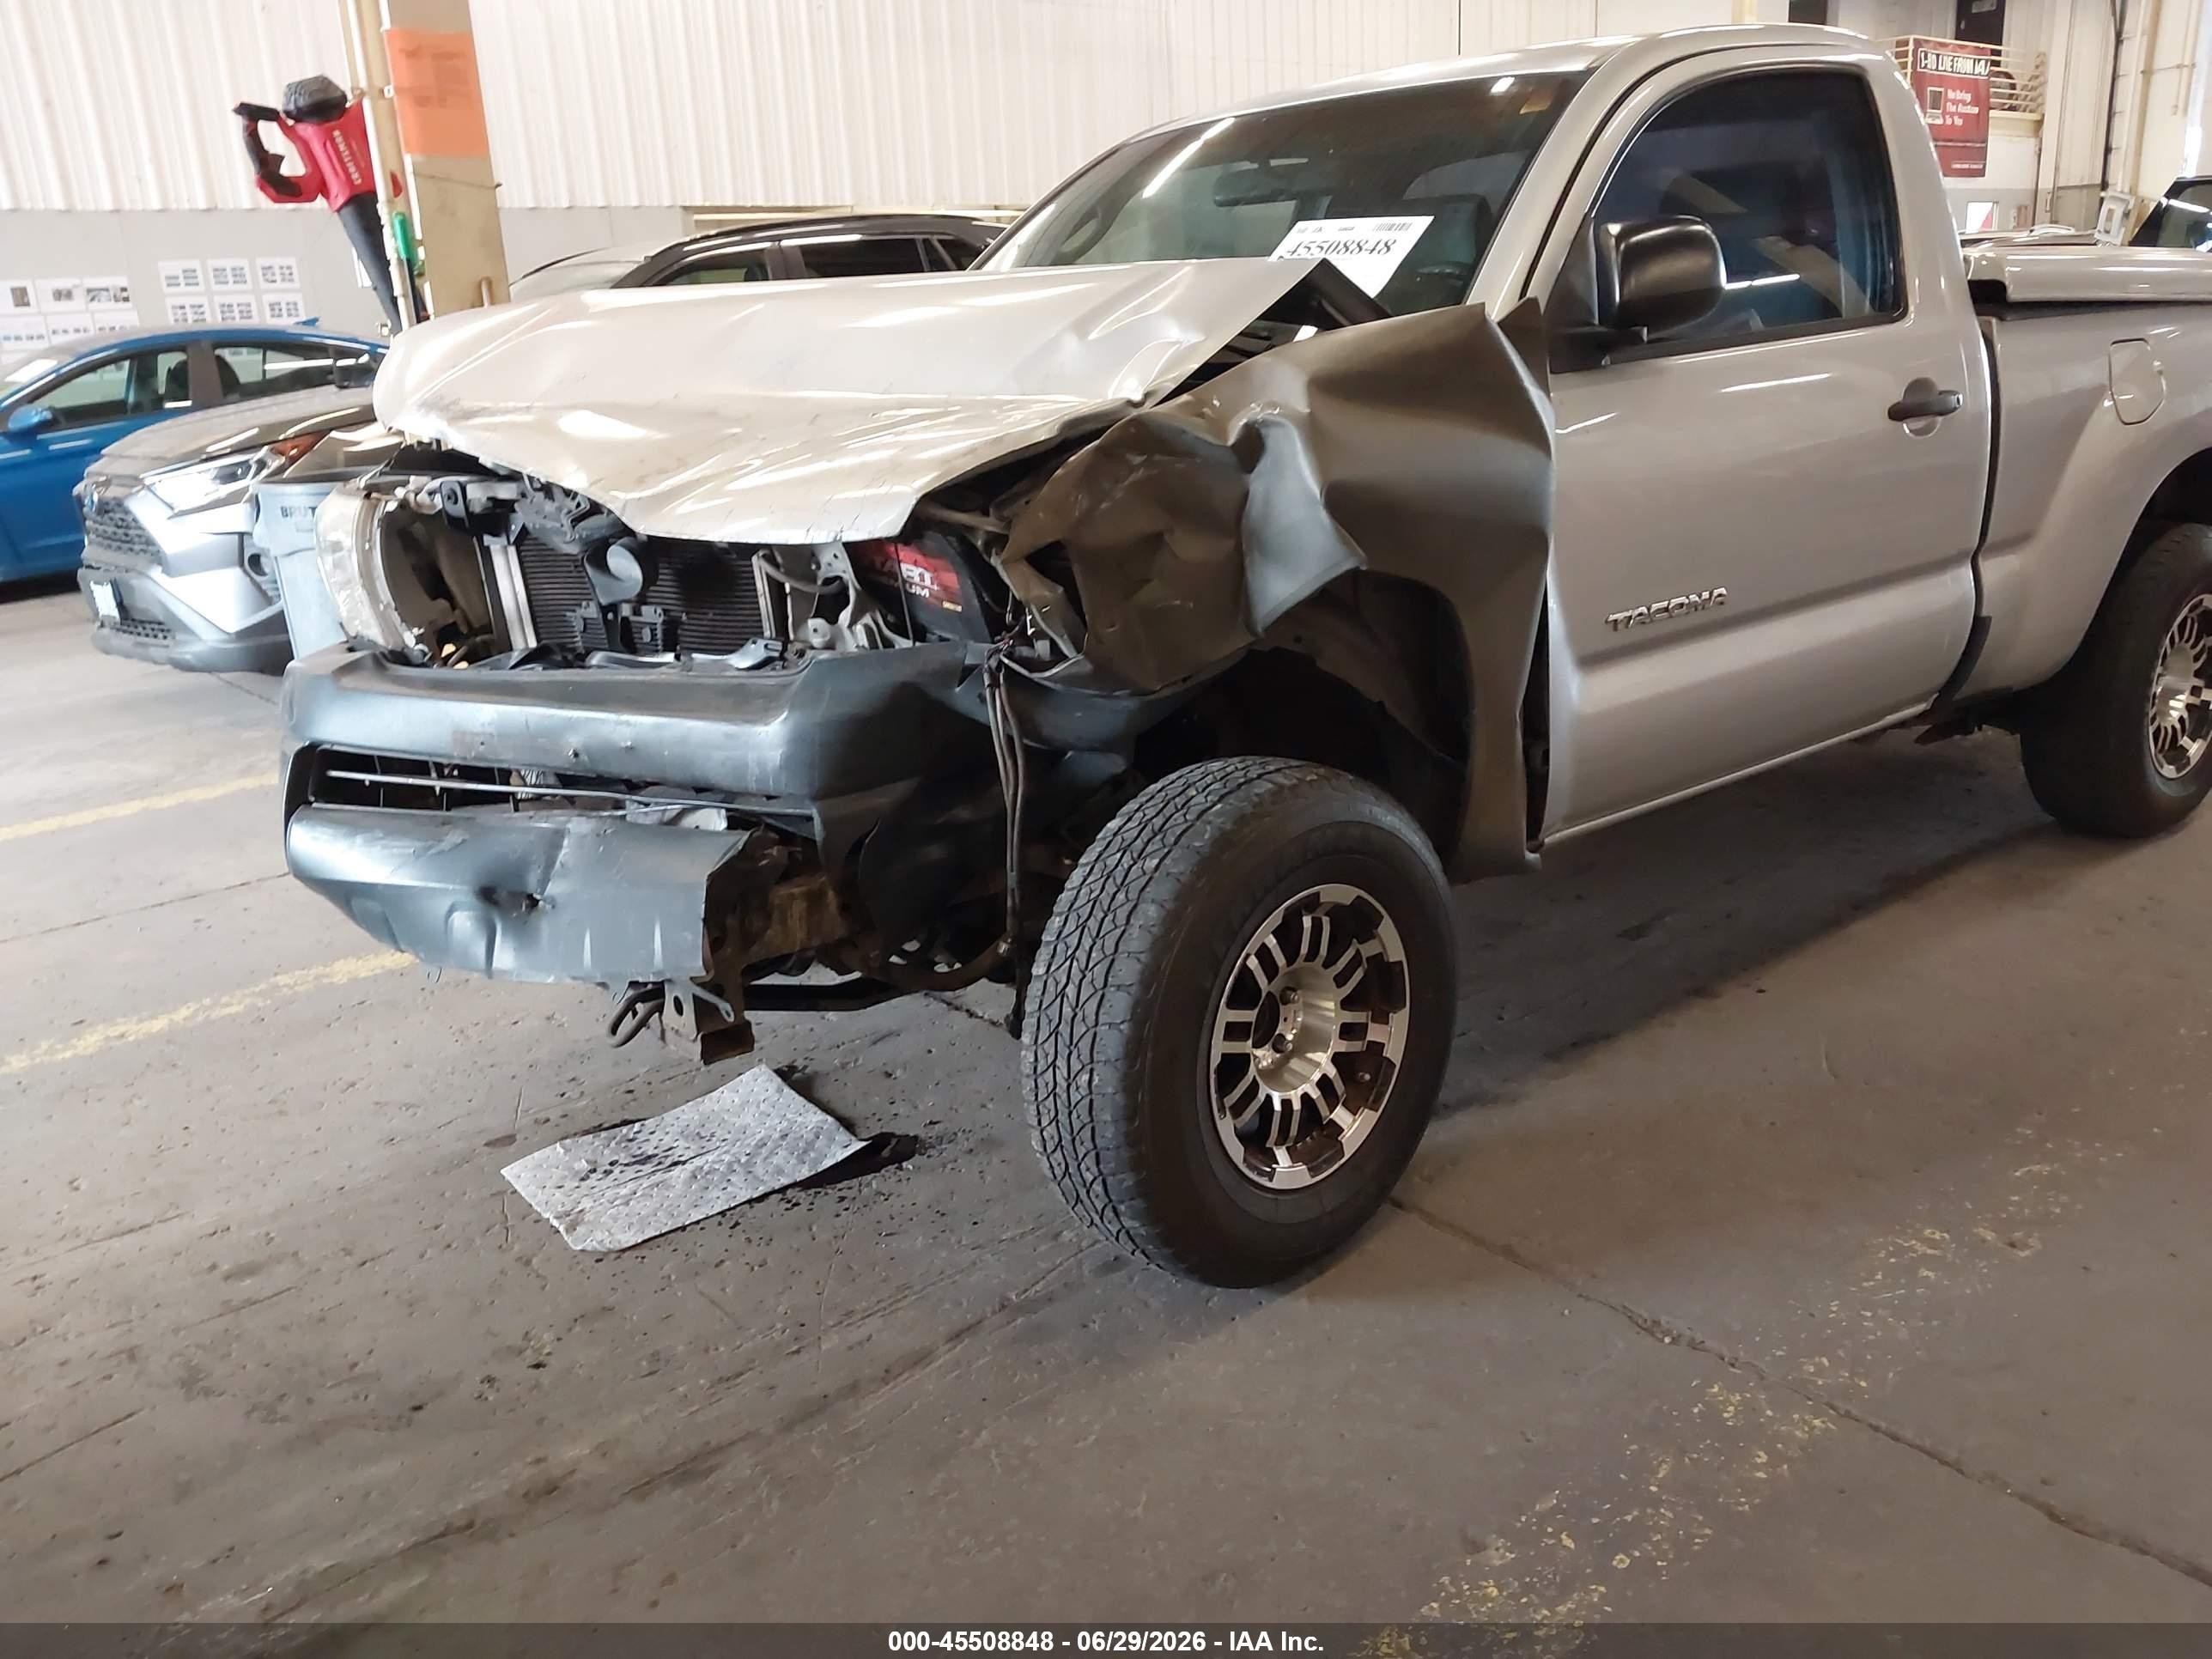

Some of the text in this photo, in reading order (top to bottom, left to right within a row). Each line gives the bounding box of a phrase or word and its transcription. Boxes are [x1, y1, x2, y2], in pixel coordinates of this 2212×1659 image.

[1953, 56, 1974, 75] FROM
[1286, 238, 1397, 257] 45508848
[280, 505, 318, 519] BRUT
[1605, 586, 1729, 631] TACOMA
